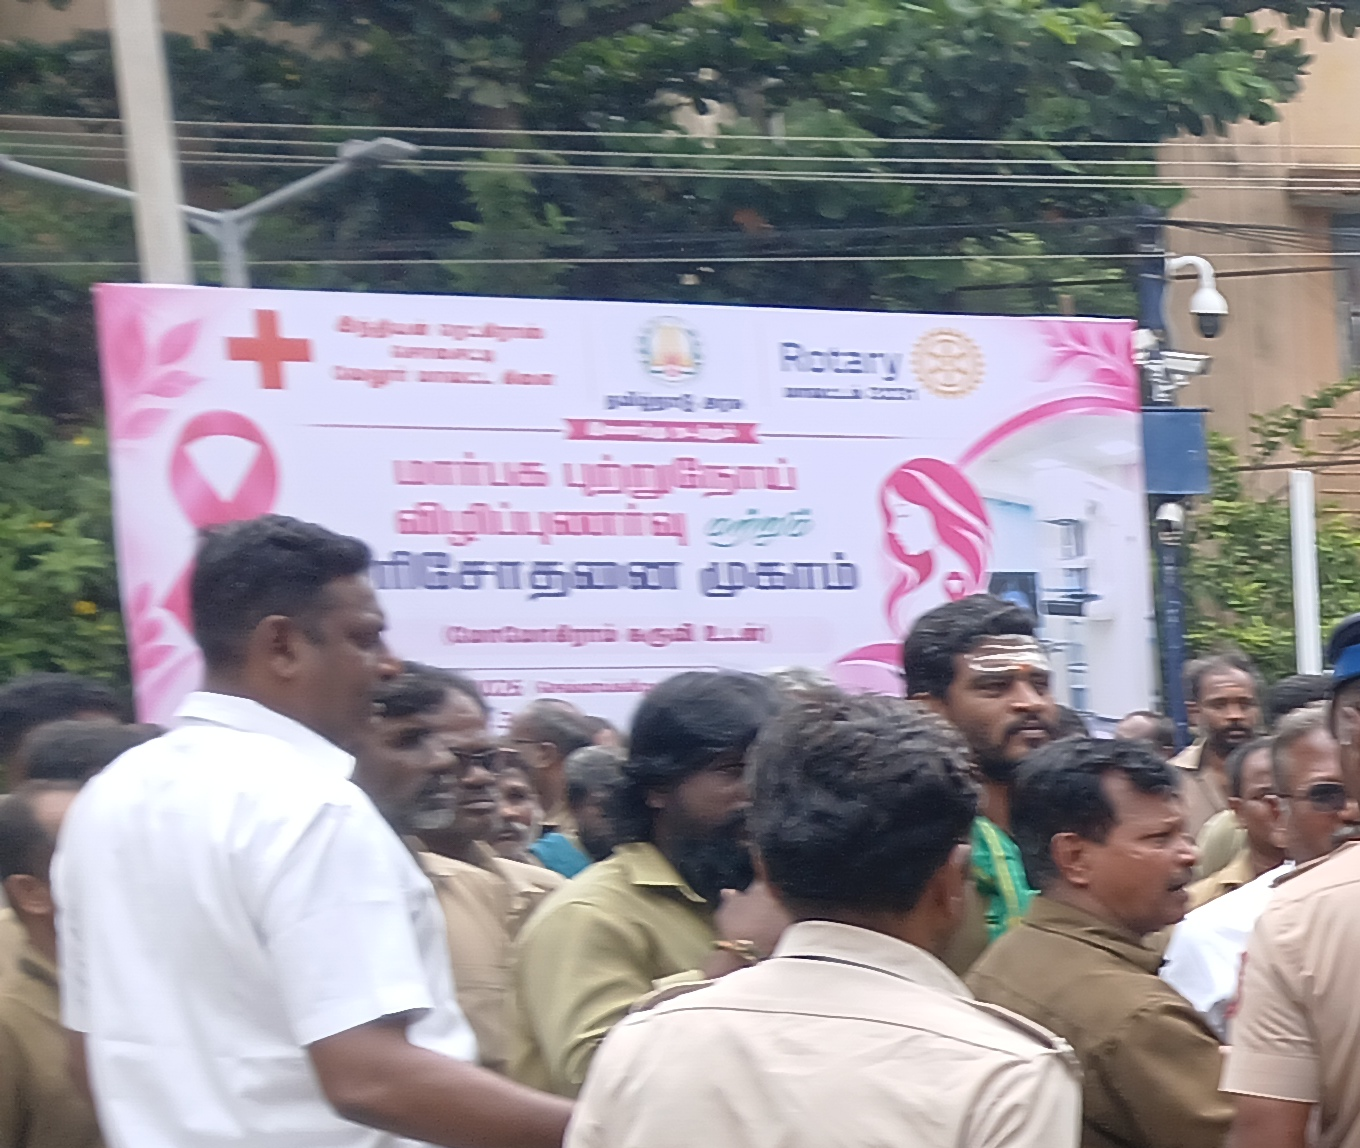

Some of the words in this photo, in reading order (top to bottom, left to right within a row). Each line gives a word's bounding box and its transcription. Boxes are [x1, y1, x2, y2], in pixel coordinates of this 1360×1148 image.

[778, 341, 904, 382] Rotary
[394, 451, 549, 486] மார்பக
[562, 454, 797, 499] புற்றுநோய்
[396, 501, 688, 546] விழிப்புணர்வு
[371, 550, 682, 600] ரிசோதனை
[698, 551, 860, 598] முகாம்
